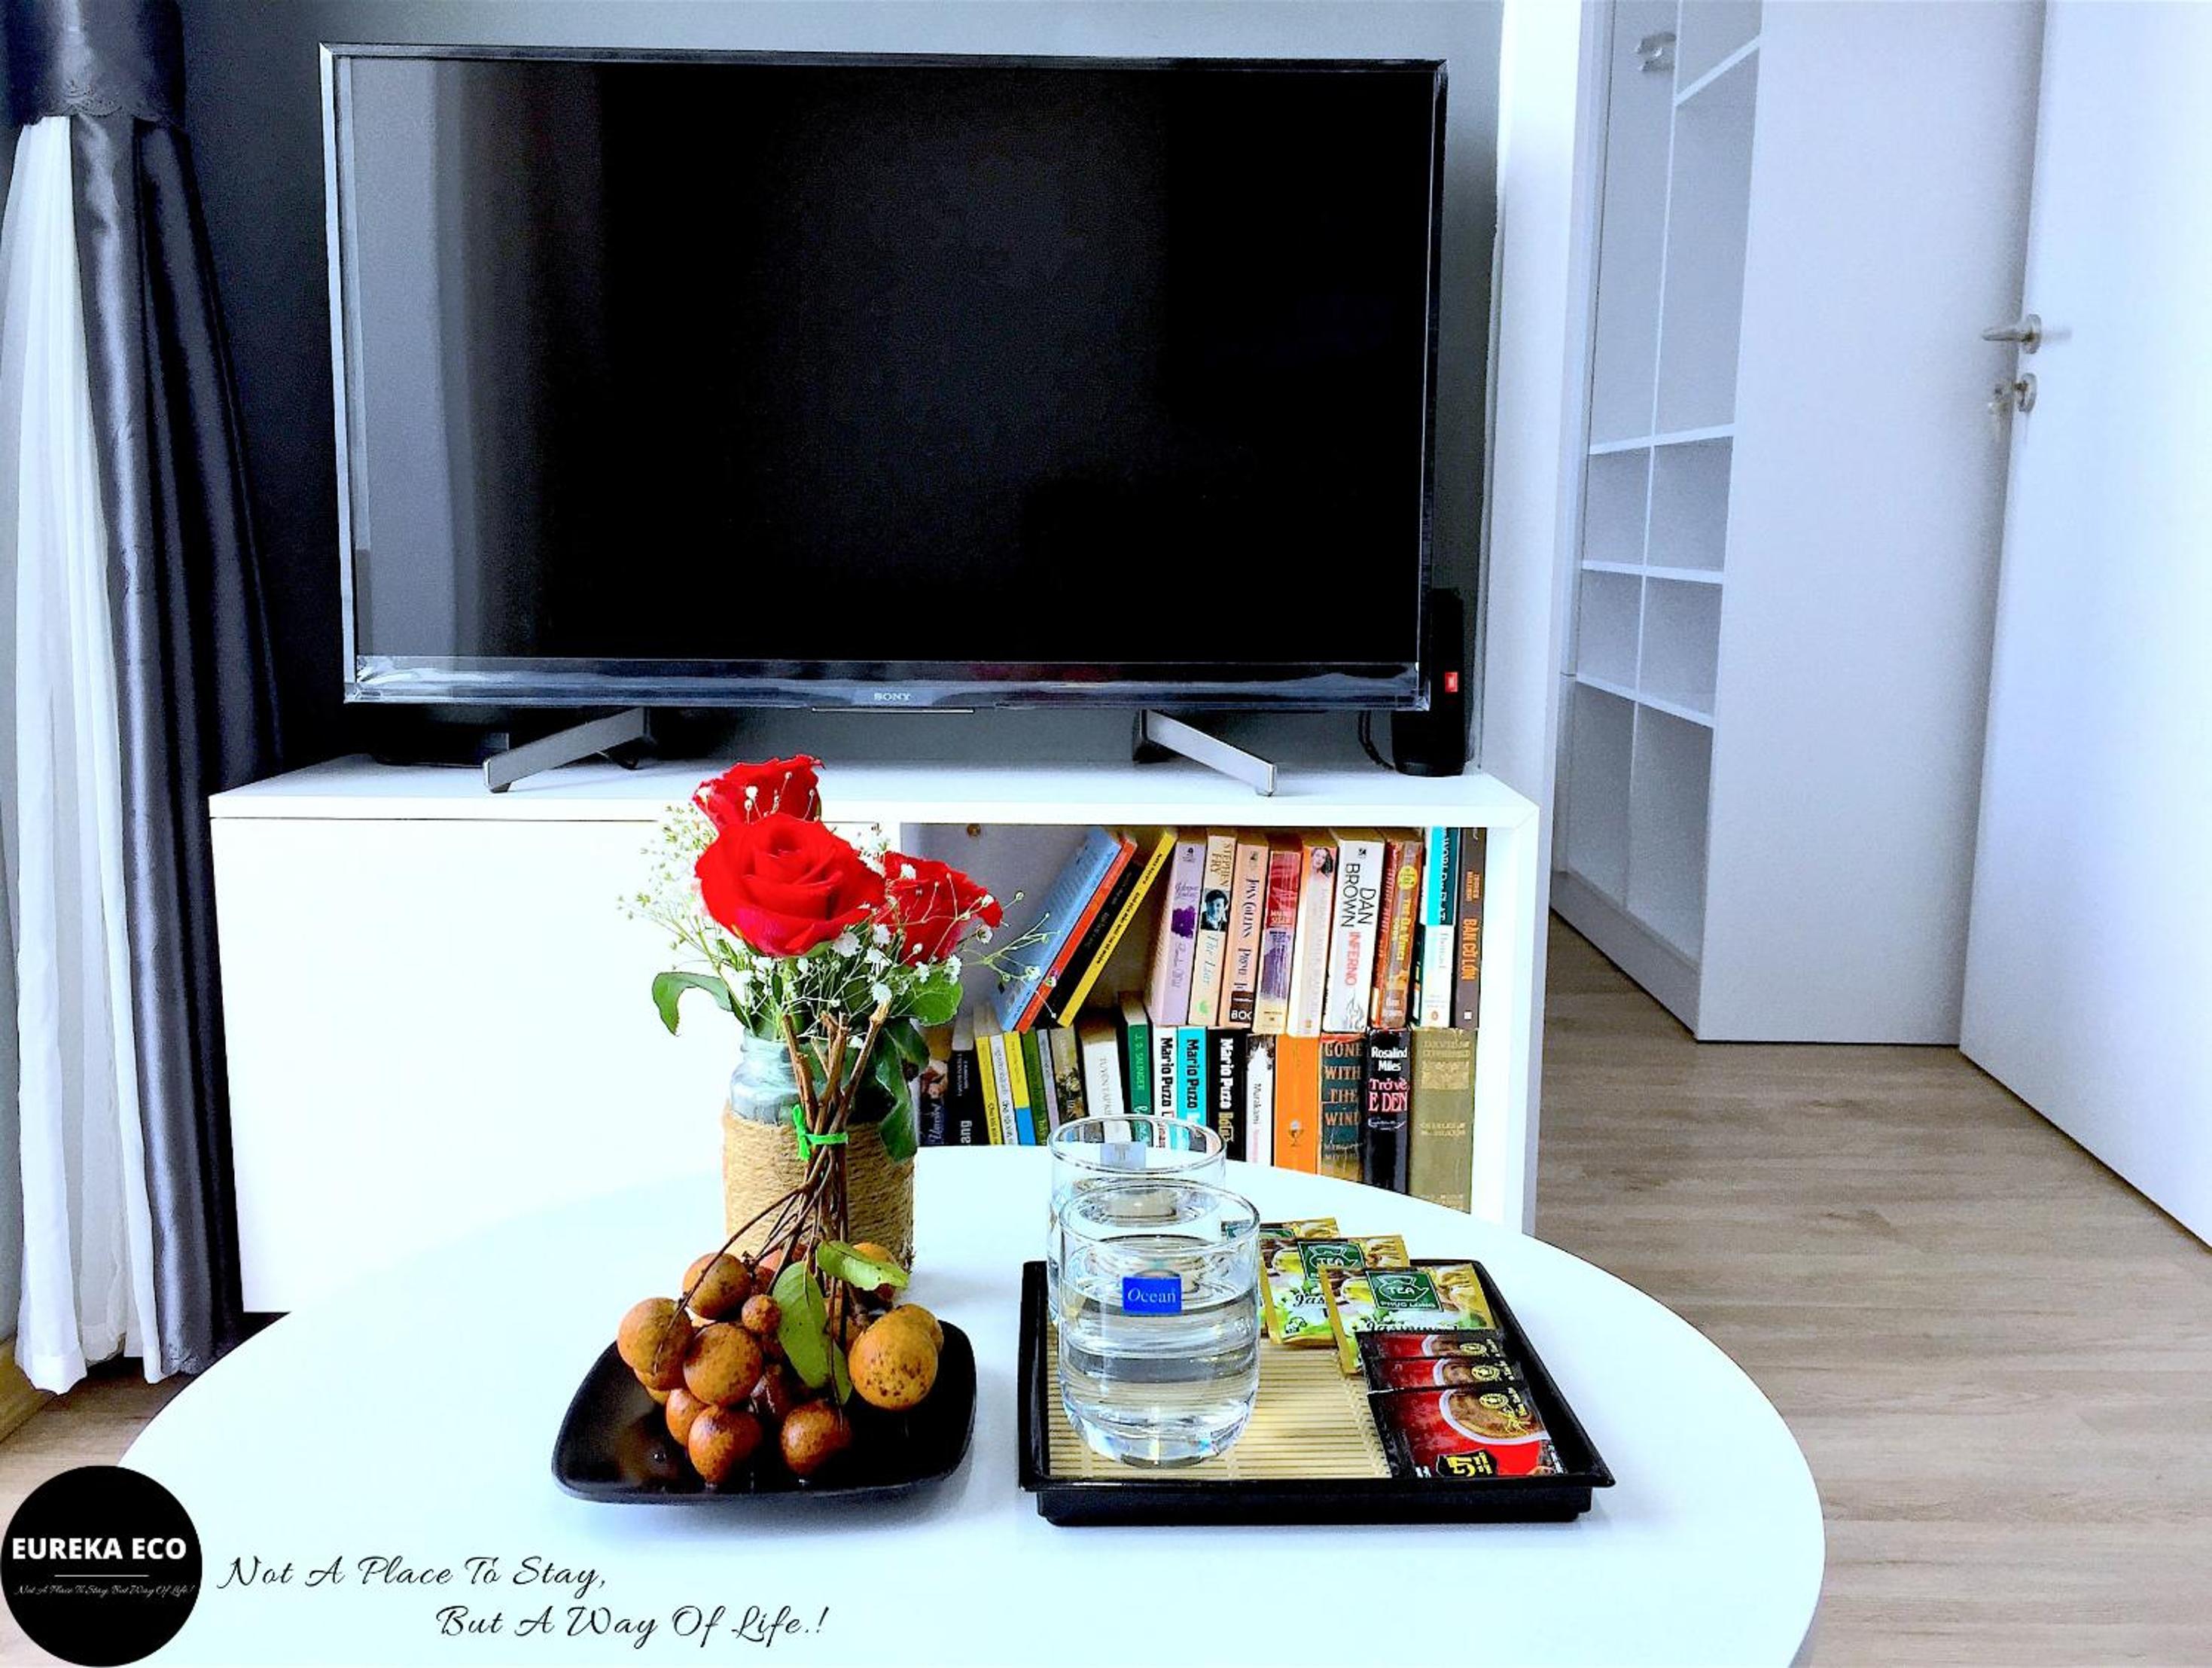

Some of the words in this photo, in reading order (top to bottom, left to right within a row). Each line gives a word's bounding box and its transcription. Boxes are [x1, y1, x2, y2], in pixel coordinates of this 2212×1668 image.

[873, 692, 911, 701] SONY
[1210, 852, 1221, 876] FRY
[1220, 842, 1233, 887] STEPHEN
[1340, 862, 1360, 929] BROWN
[1356, 887, 1377, 925] DAN
[1462, 918, 1479, 942] BÀN
[1345, 931, 1362, 986] INFERNO
[1160, 1037, 1175, 1075] Mario
[1186, 1038, 1199, 1075] Mario
[1219, 1038, 1235, 1077] Mario
[1324, 1042, 1363, 1057] GONE
[1371, 1046, 1408, 1059] Rosalind
[1324, 1066, 1362, 1081] WITH
[1378, 1060, 1402, 1072] Miles
[1161, 1076, 1174, 1107] Puzo
[1186, 1078, 1199, 1108] Puzo
[1219, 1078, 1234, 1109] Puzo
[1252, 1083, 1262, 1125] Murakami
[1330, 1088, 1359, 1103] THE
[1324, 1111, 1361, 1127] WIND
[1126, 1287, 1177, 1304] Ocean
[1387, 1285, 1415, 1294] TEA
